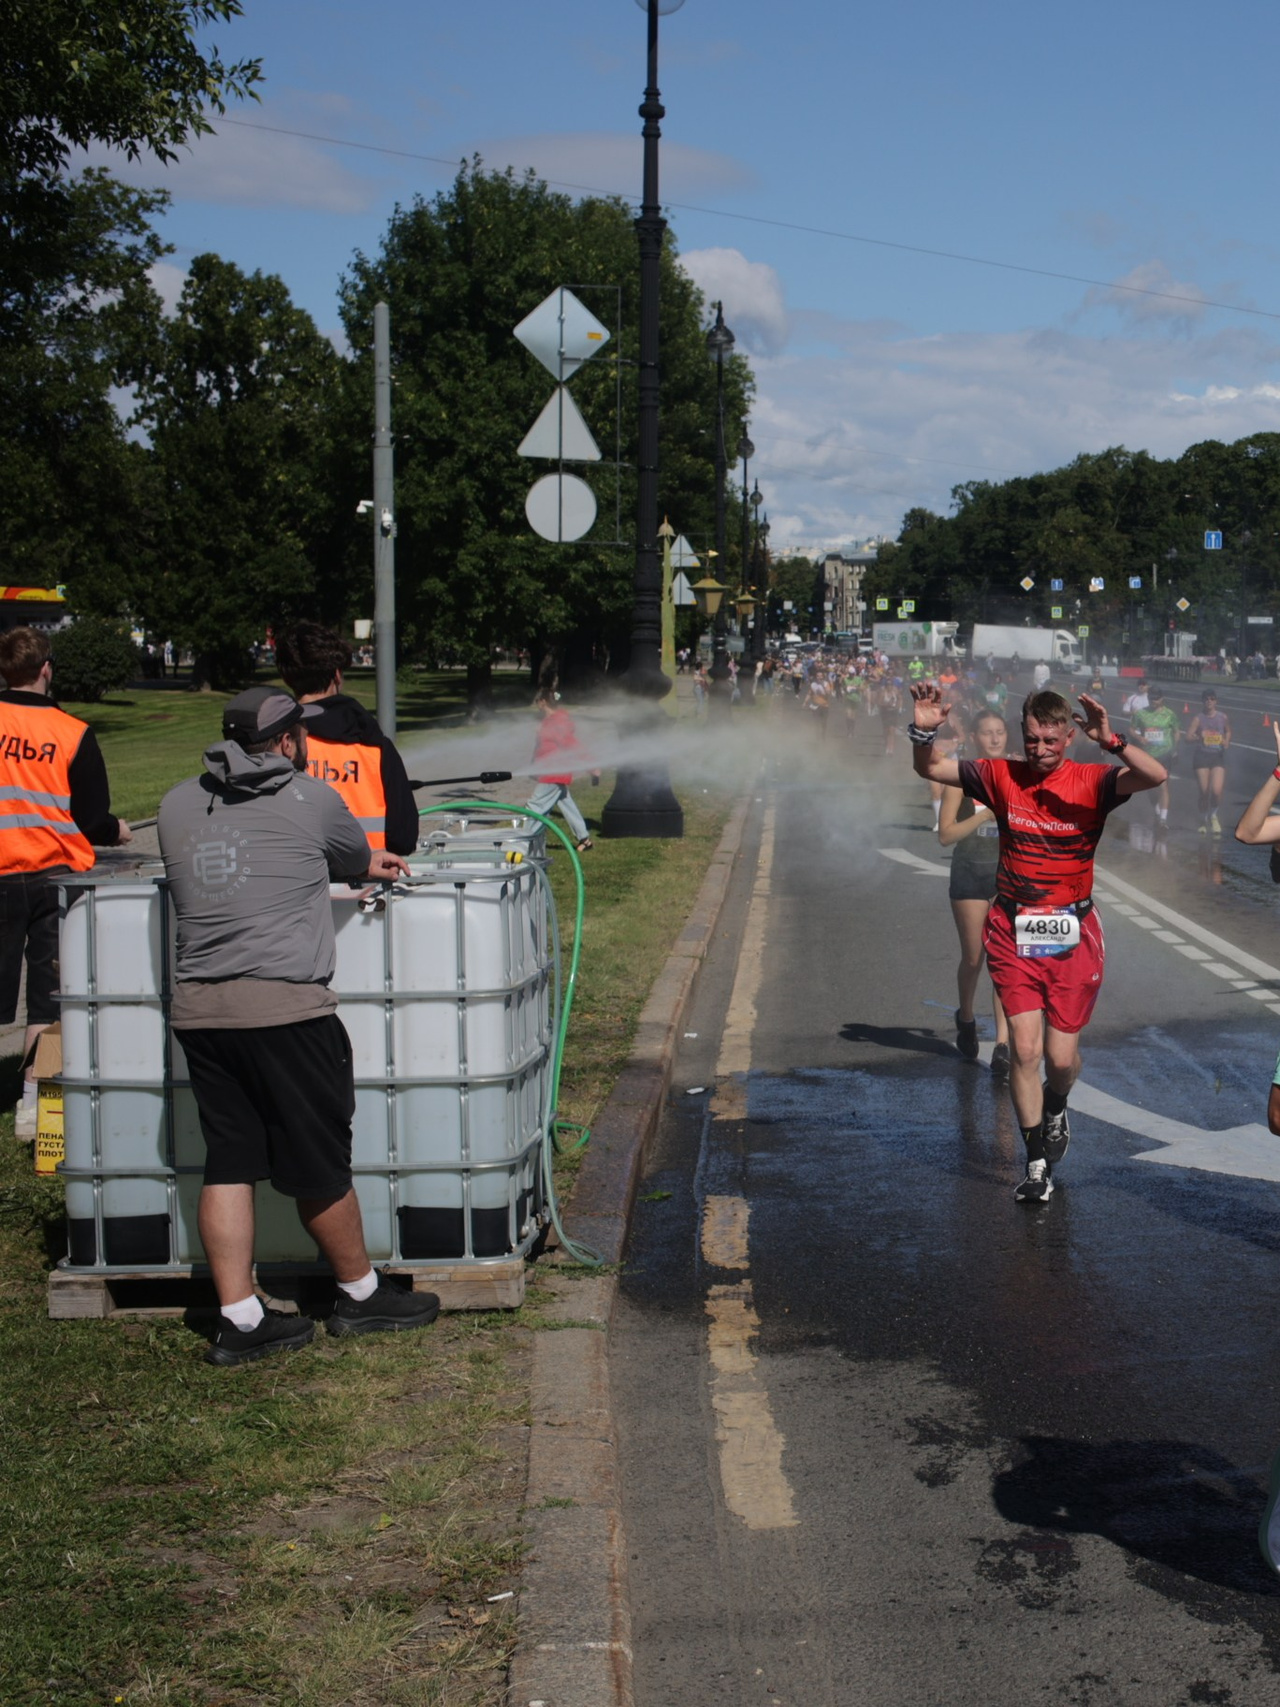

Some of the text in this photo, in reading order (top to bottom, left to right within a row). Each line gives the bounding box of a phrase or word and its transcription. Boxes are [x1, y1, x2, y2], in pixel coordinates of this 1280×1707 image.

[184, 866, 251, 903] ООБЩЕСТВО
[1024, 918, 1071, 936] 4830
[1023, 945, 1031, 956] E
[38, 1132, 64, 1140] ПЕНА
[38, 1150, 64, 1158] ПЛОТ
